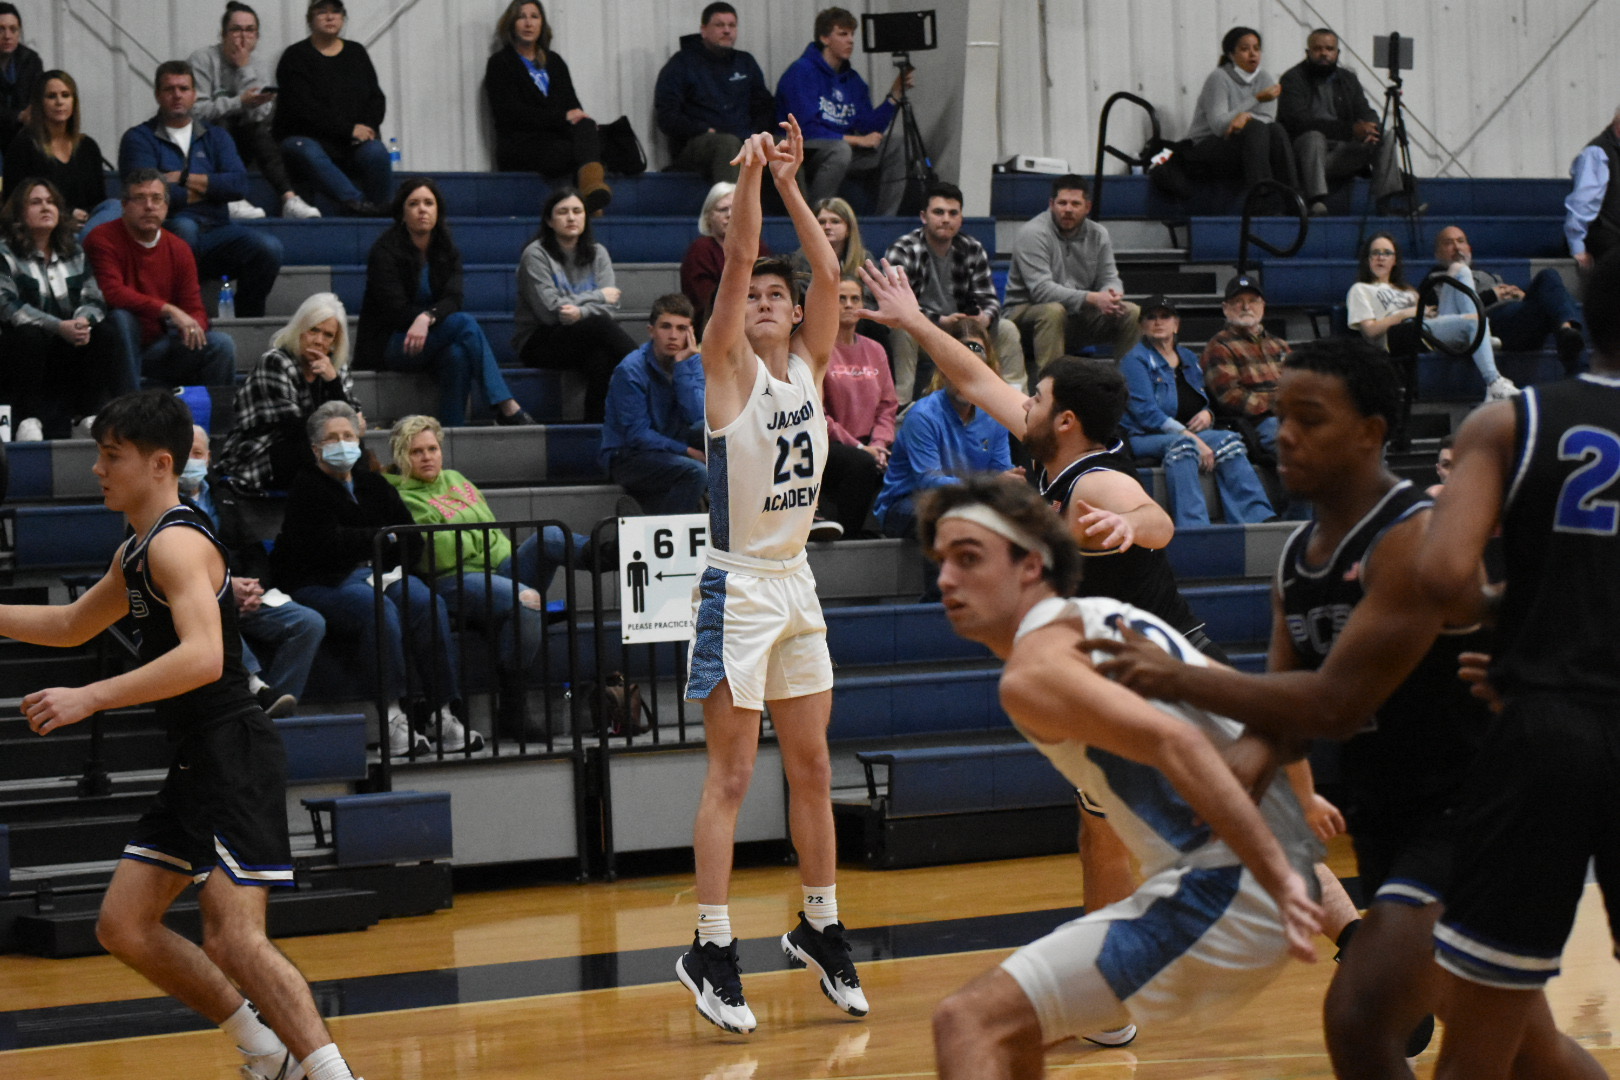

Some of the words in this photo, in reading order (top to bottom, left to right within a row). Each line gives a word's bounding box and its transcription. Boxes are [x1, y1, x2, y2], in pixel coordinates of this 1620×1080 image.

[767, 400, 814, 430] JACSON
[773, 430, 815, 485] 23
[653, 528, 674, 559] 6
[689, 527, 706, 557] F
[627, 622, 652, 631] PLEASE
[654, 620, 688, 630] PRACTICE
